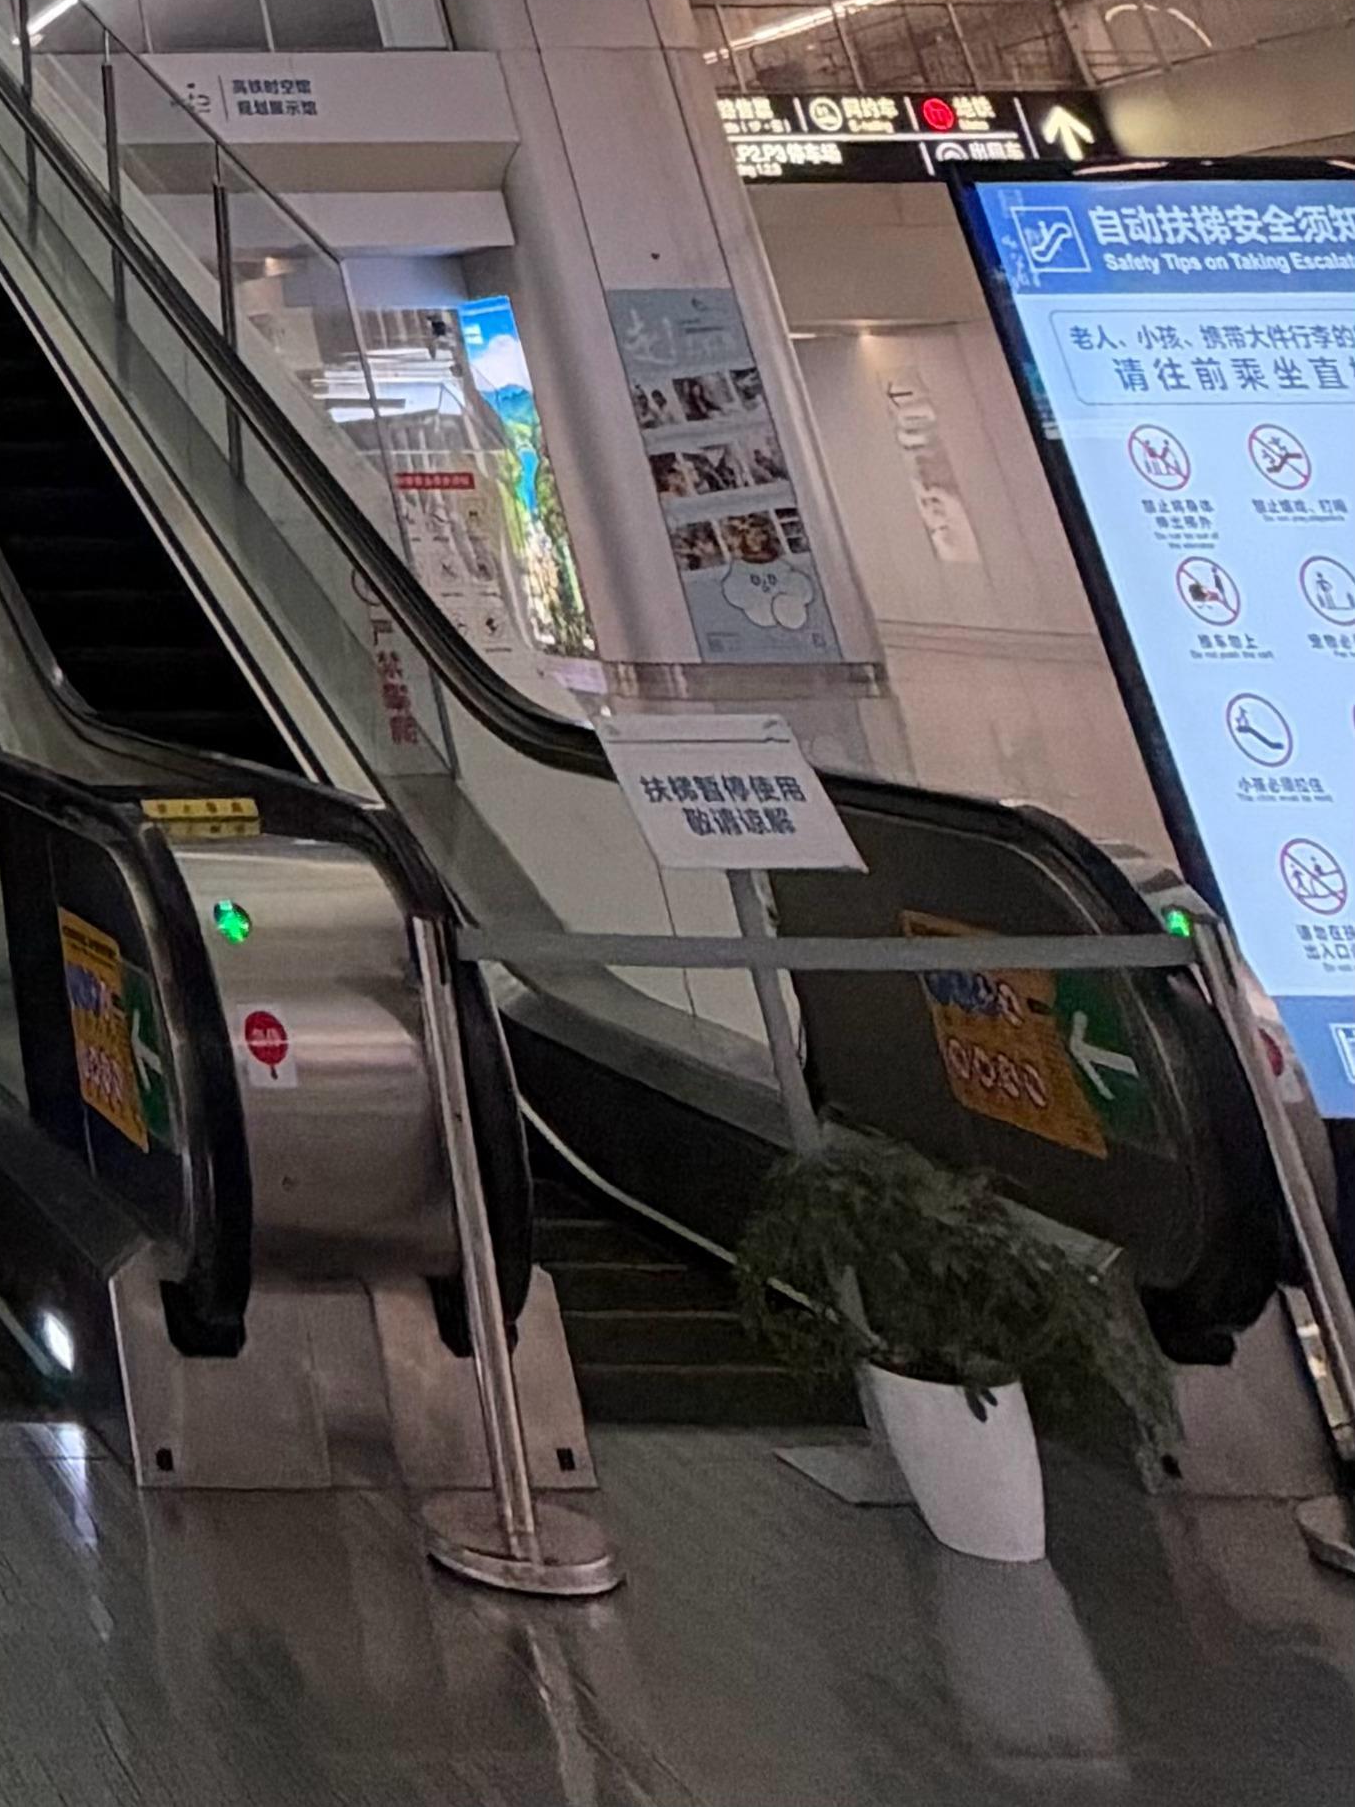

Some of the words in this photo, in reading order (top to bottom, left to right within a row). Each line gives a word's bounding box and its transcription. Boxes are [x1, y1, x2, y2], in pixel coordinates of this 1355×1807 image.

[1105, 252, 1161, 275] Safety
[1164, 251, 1201, 274] Tips
[1204, 256, 1228, 271] on
[1232, 250, 1292, 275] Taking
[1113, 355, 1355, 393] 请往前乘坐直
[640, 774, 807, 803] 扶梯暂停使用
[681, 807, 797, 837] 敬请谅解
